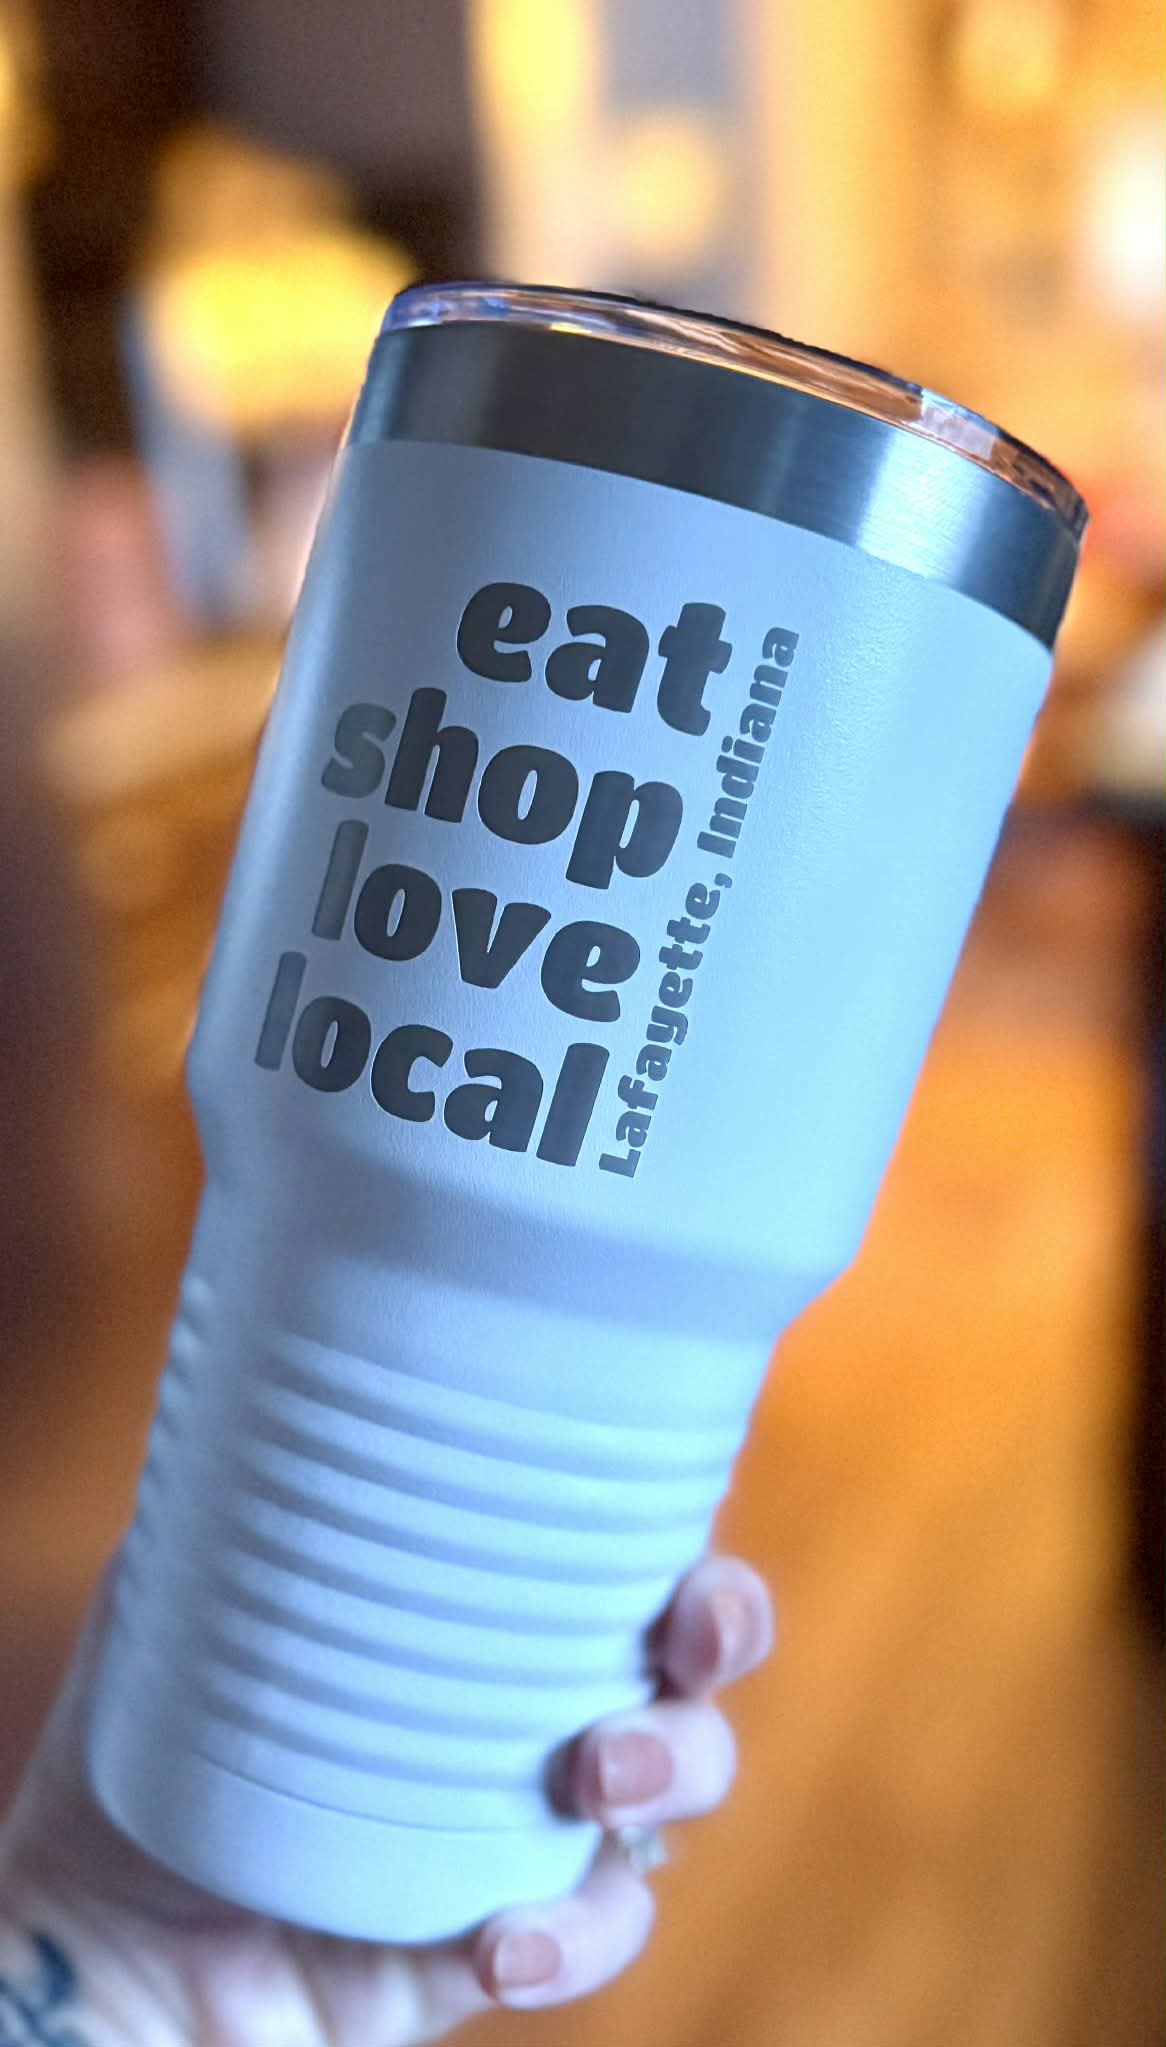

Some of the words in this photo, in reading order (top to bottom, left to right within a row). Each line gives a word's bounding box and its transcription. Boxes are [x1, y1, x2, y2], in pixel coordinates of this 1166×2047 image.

[456, 582, 733, 737] eat
[320, 687, 683, 890] shop
[311, 819, 641, 1023] love
[598, 872, 733, 1179] Lafayette,
[697, 626, 800, 860] Indiana
[254, 951, 610, 1168] local
